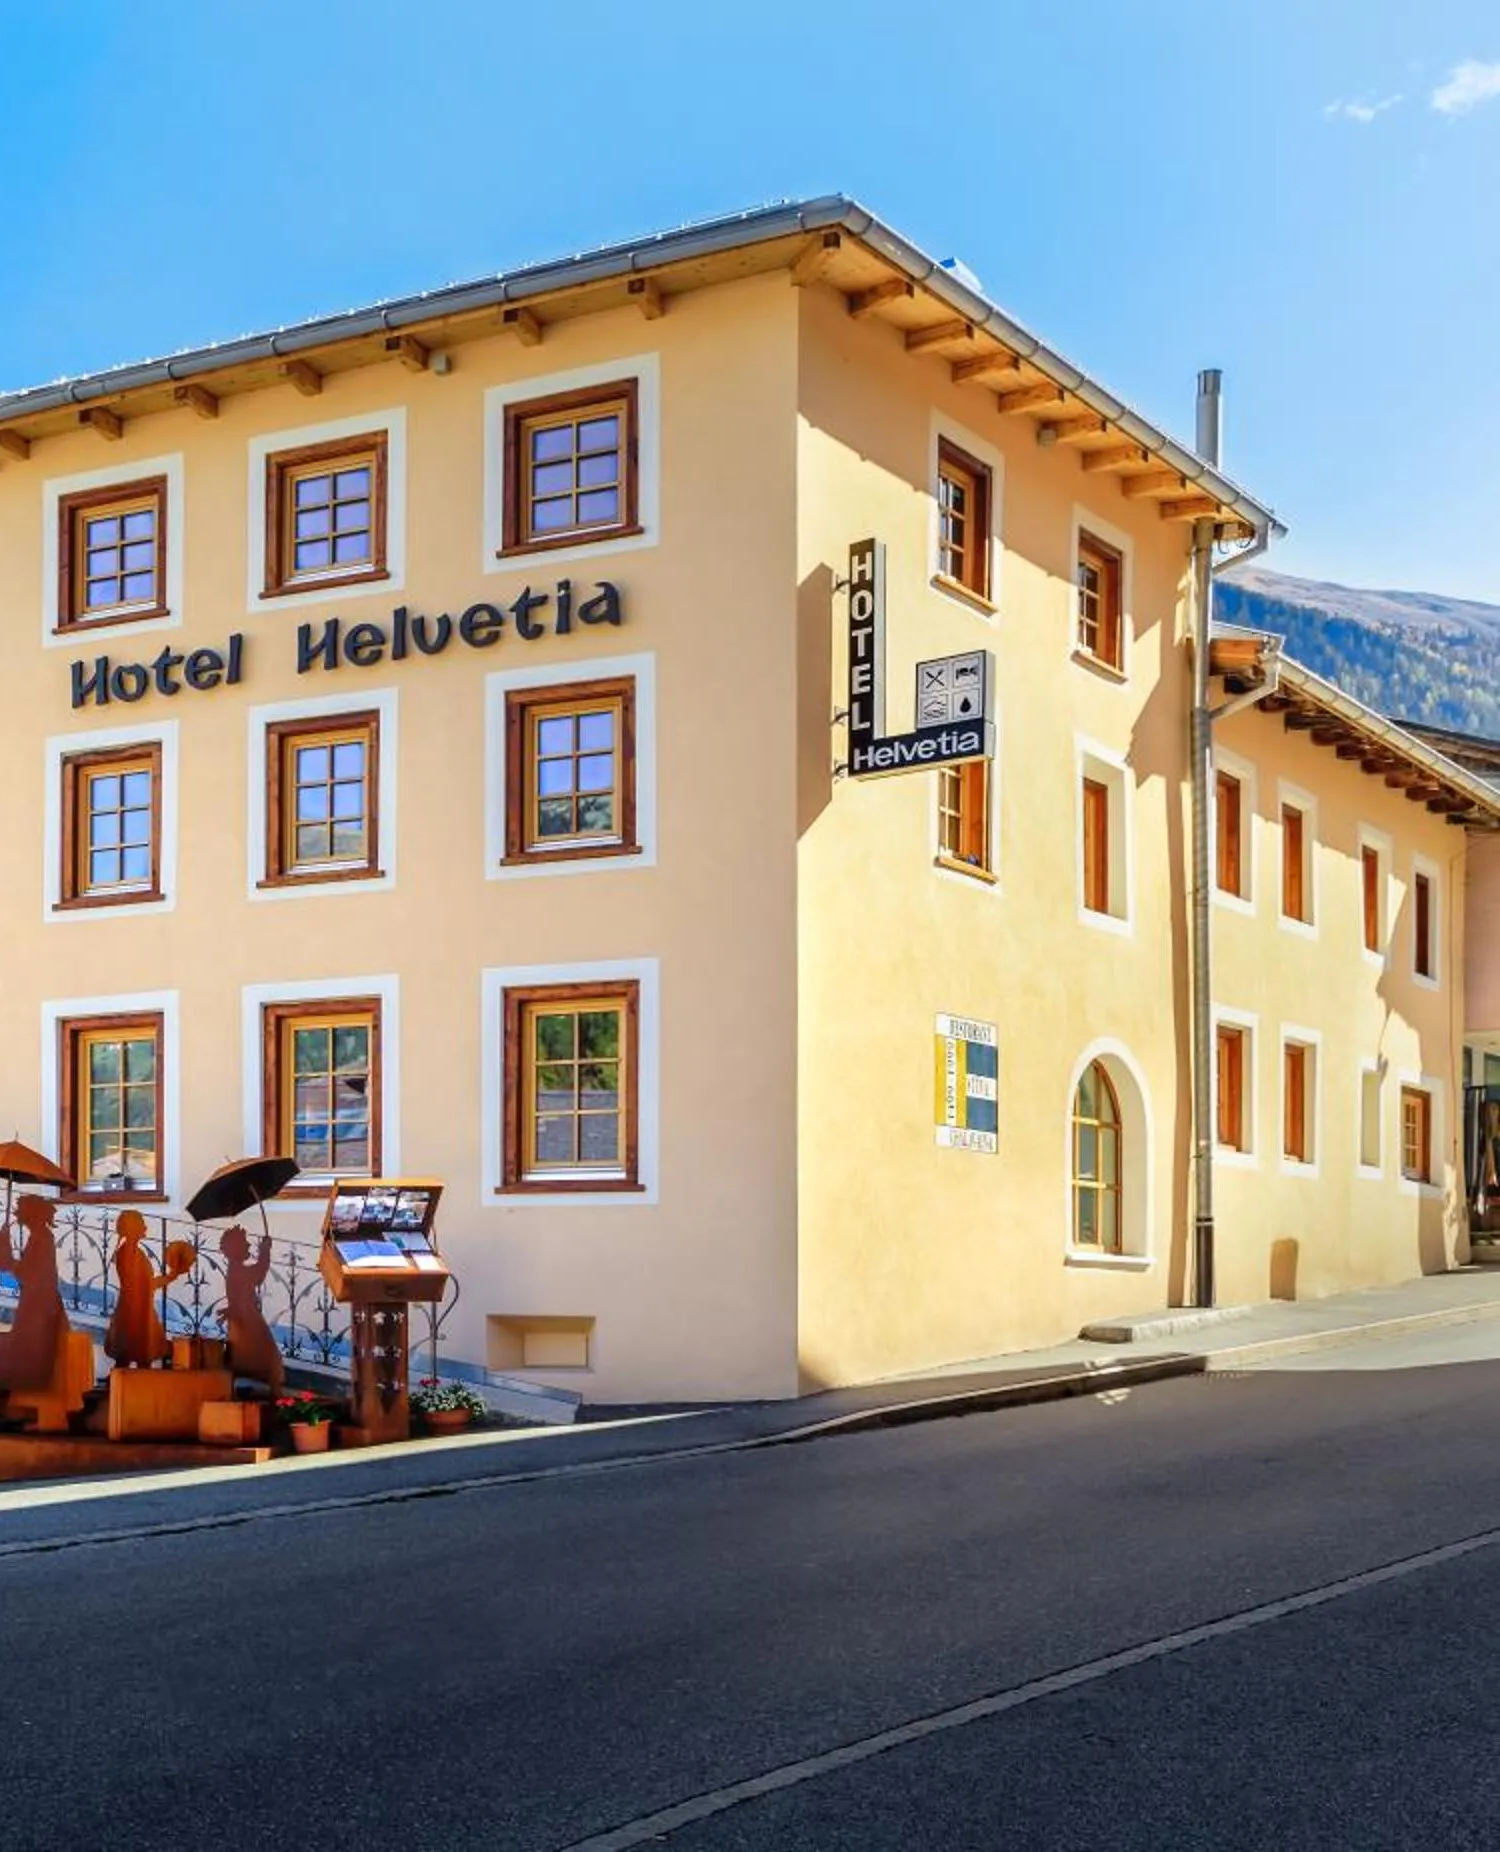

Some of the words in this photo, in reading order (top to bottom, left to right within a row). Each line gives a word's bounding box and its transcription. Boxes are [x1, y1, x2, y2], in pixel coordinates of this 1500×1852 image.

[70, 633, 243, 709] Hotel
[296, 579, 623, 674] Helvetia
[851, 551, 873, 731] HOTEL
[853, 730, 980, 771] Helvetia
